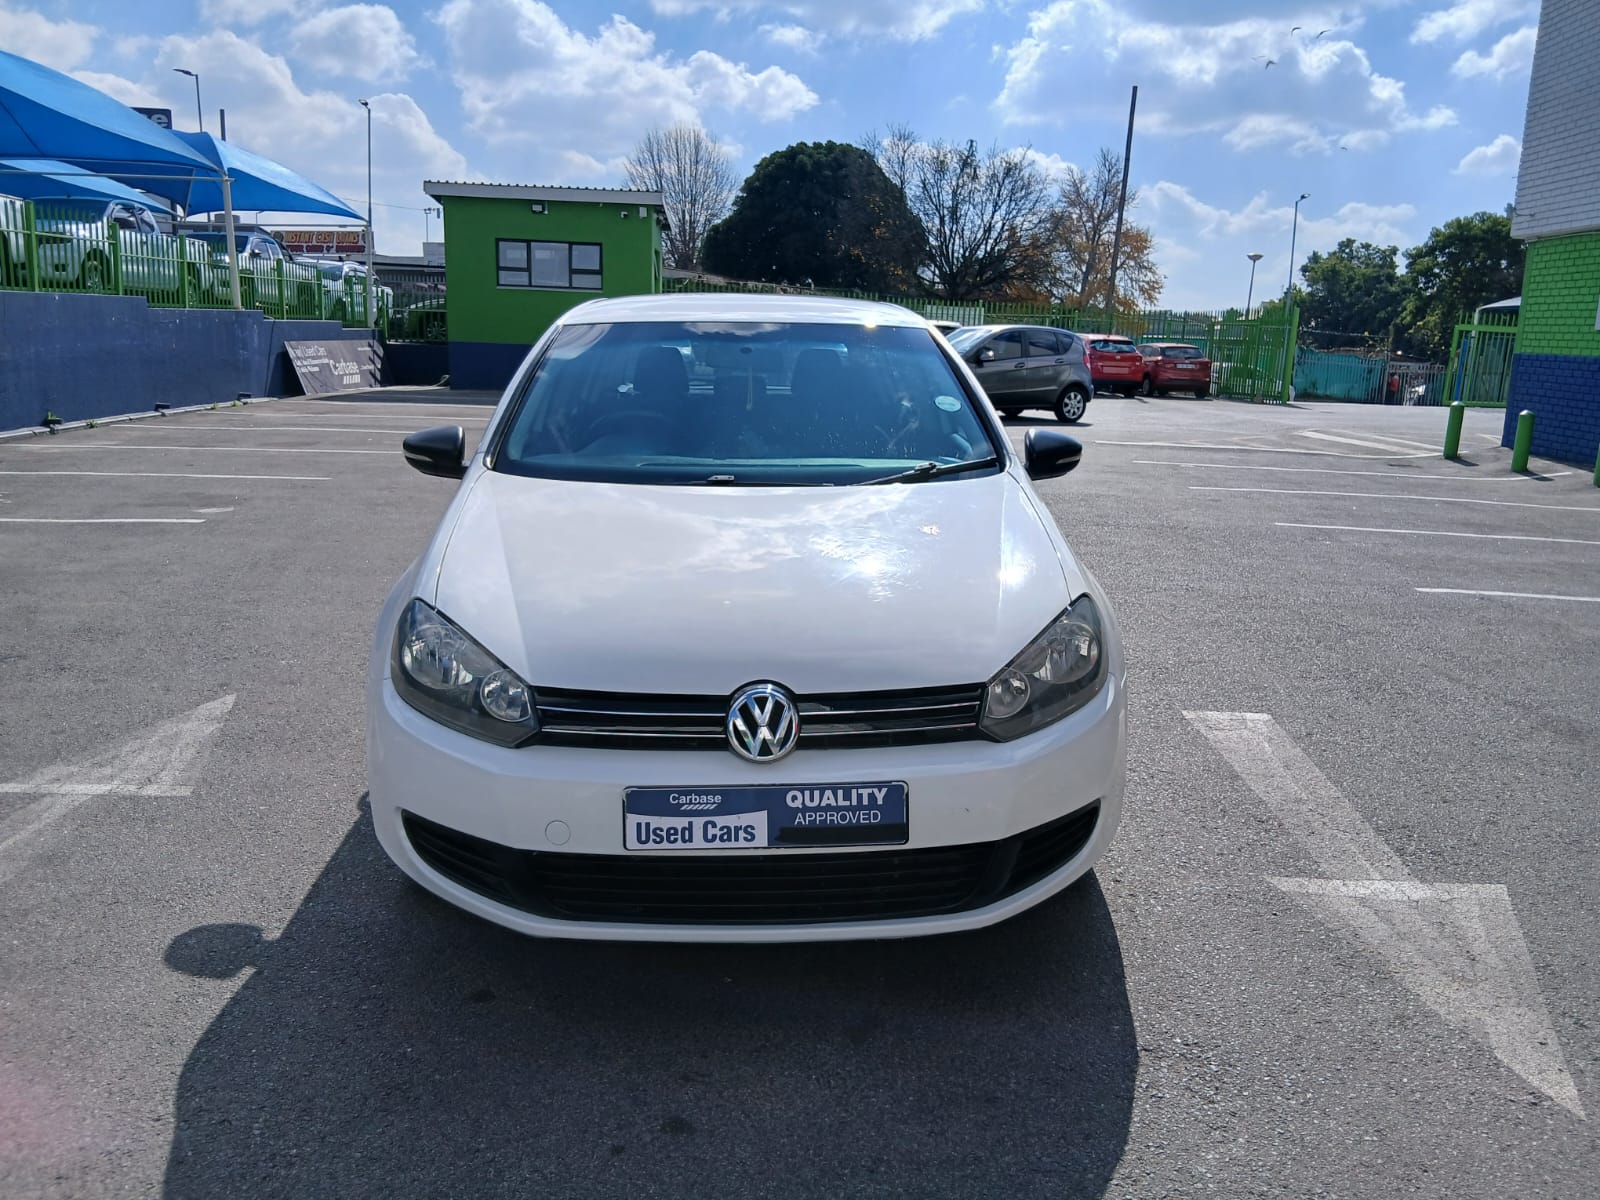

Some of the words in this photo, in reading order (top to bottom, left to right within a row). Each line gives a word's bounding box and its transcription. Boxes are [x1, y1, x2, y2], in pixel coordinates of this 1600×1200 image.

[284, 231, 315, 244] INSTANT
[329, 358, 360, 375] Carbase
[669, 793, 722, 804] Carbase
[785, 787, 888, 809] QUALITY
[794, 810, 881, 825] APPROVED
[635, 821, 694, 845] Used
[702, 820, 756, 843] Cars
